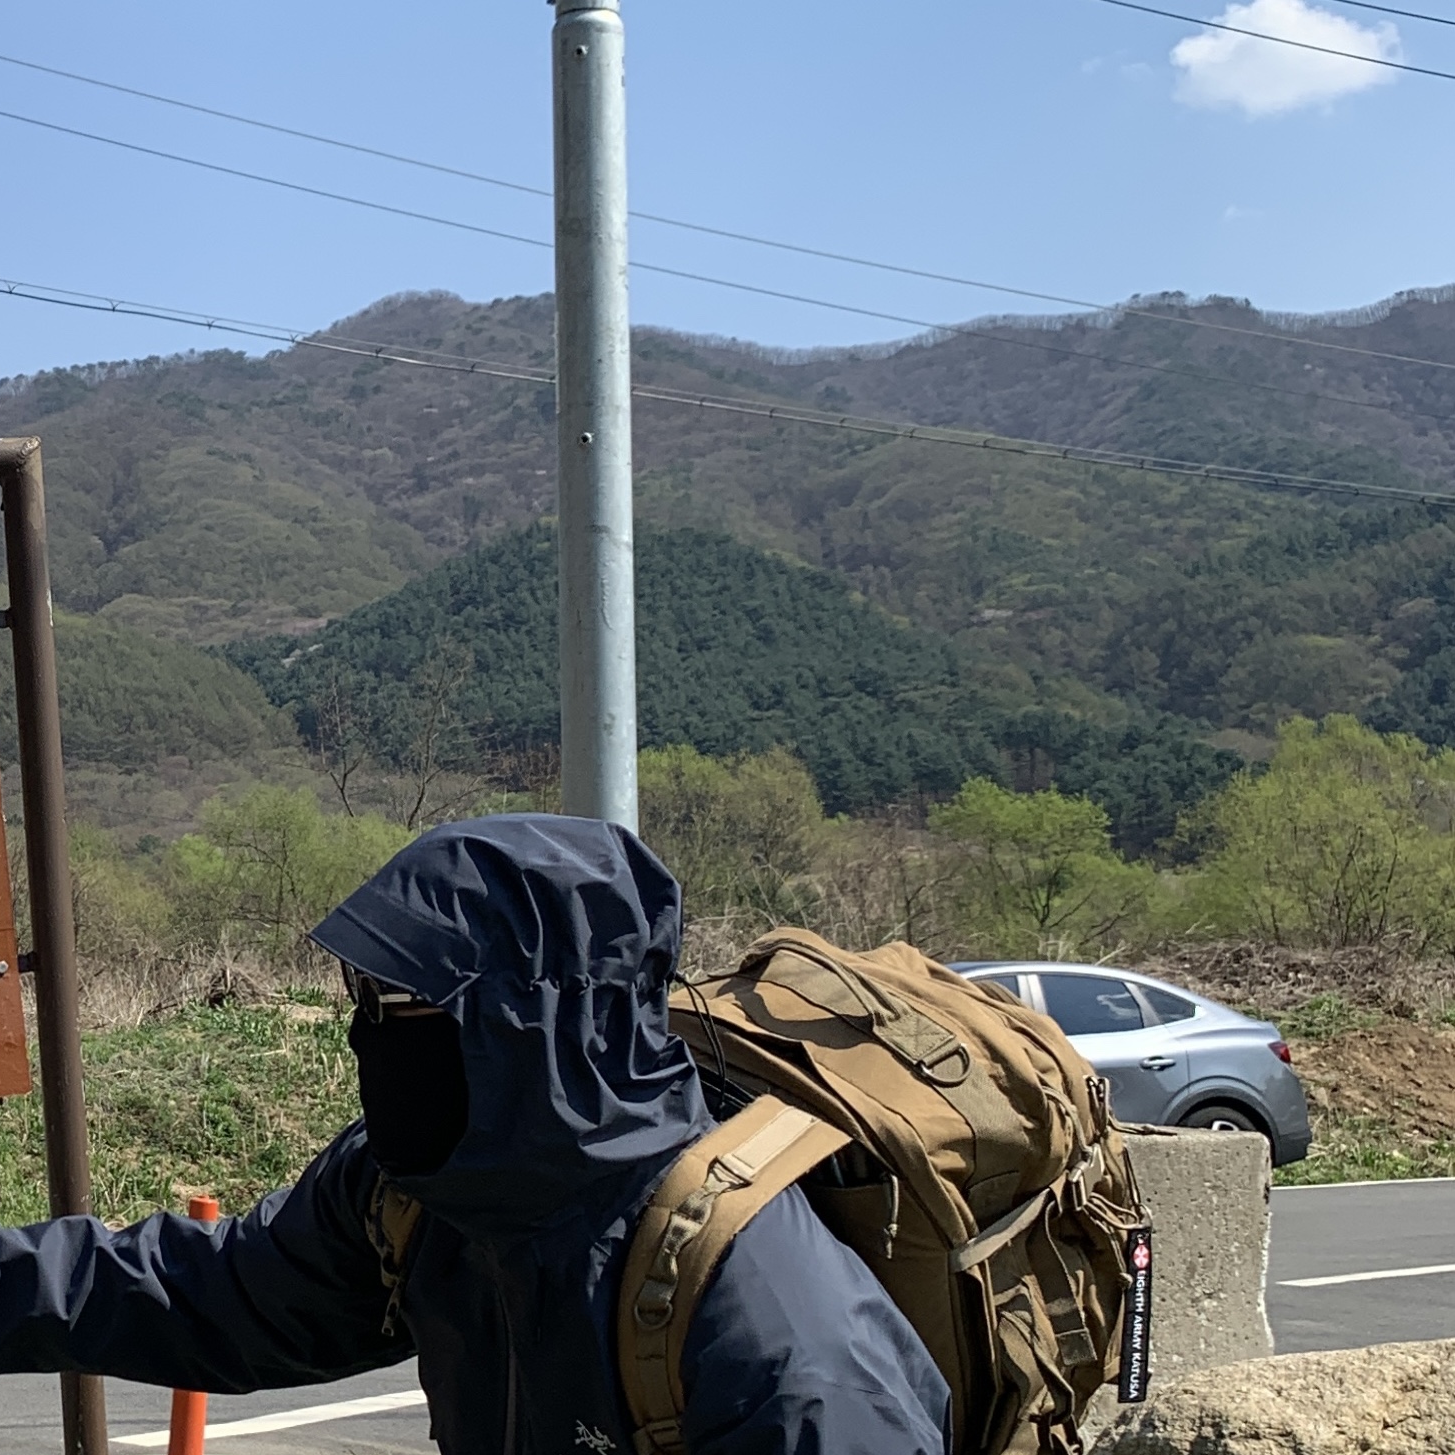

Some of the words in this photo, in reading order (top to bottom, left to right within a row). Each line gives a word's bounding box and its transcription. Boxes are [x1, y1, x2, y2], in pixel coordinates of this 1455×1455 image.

[1136, 1270, 1146, 1313] EIGHTH
[1133, 1316, 1144, 1350] ARMY
[1130, 1353, 1142, 1399] KATUSA
